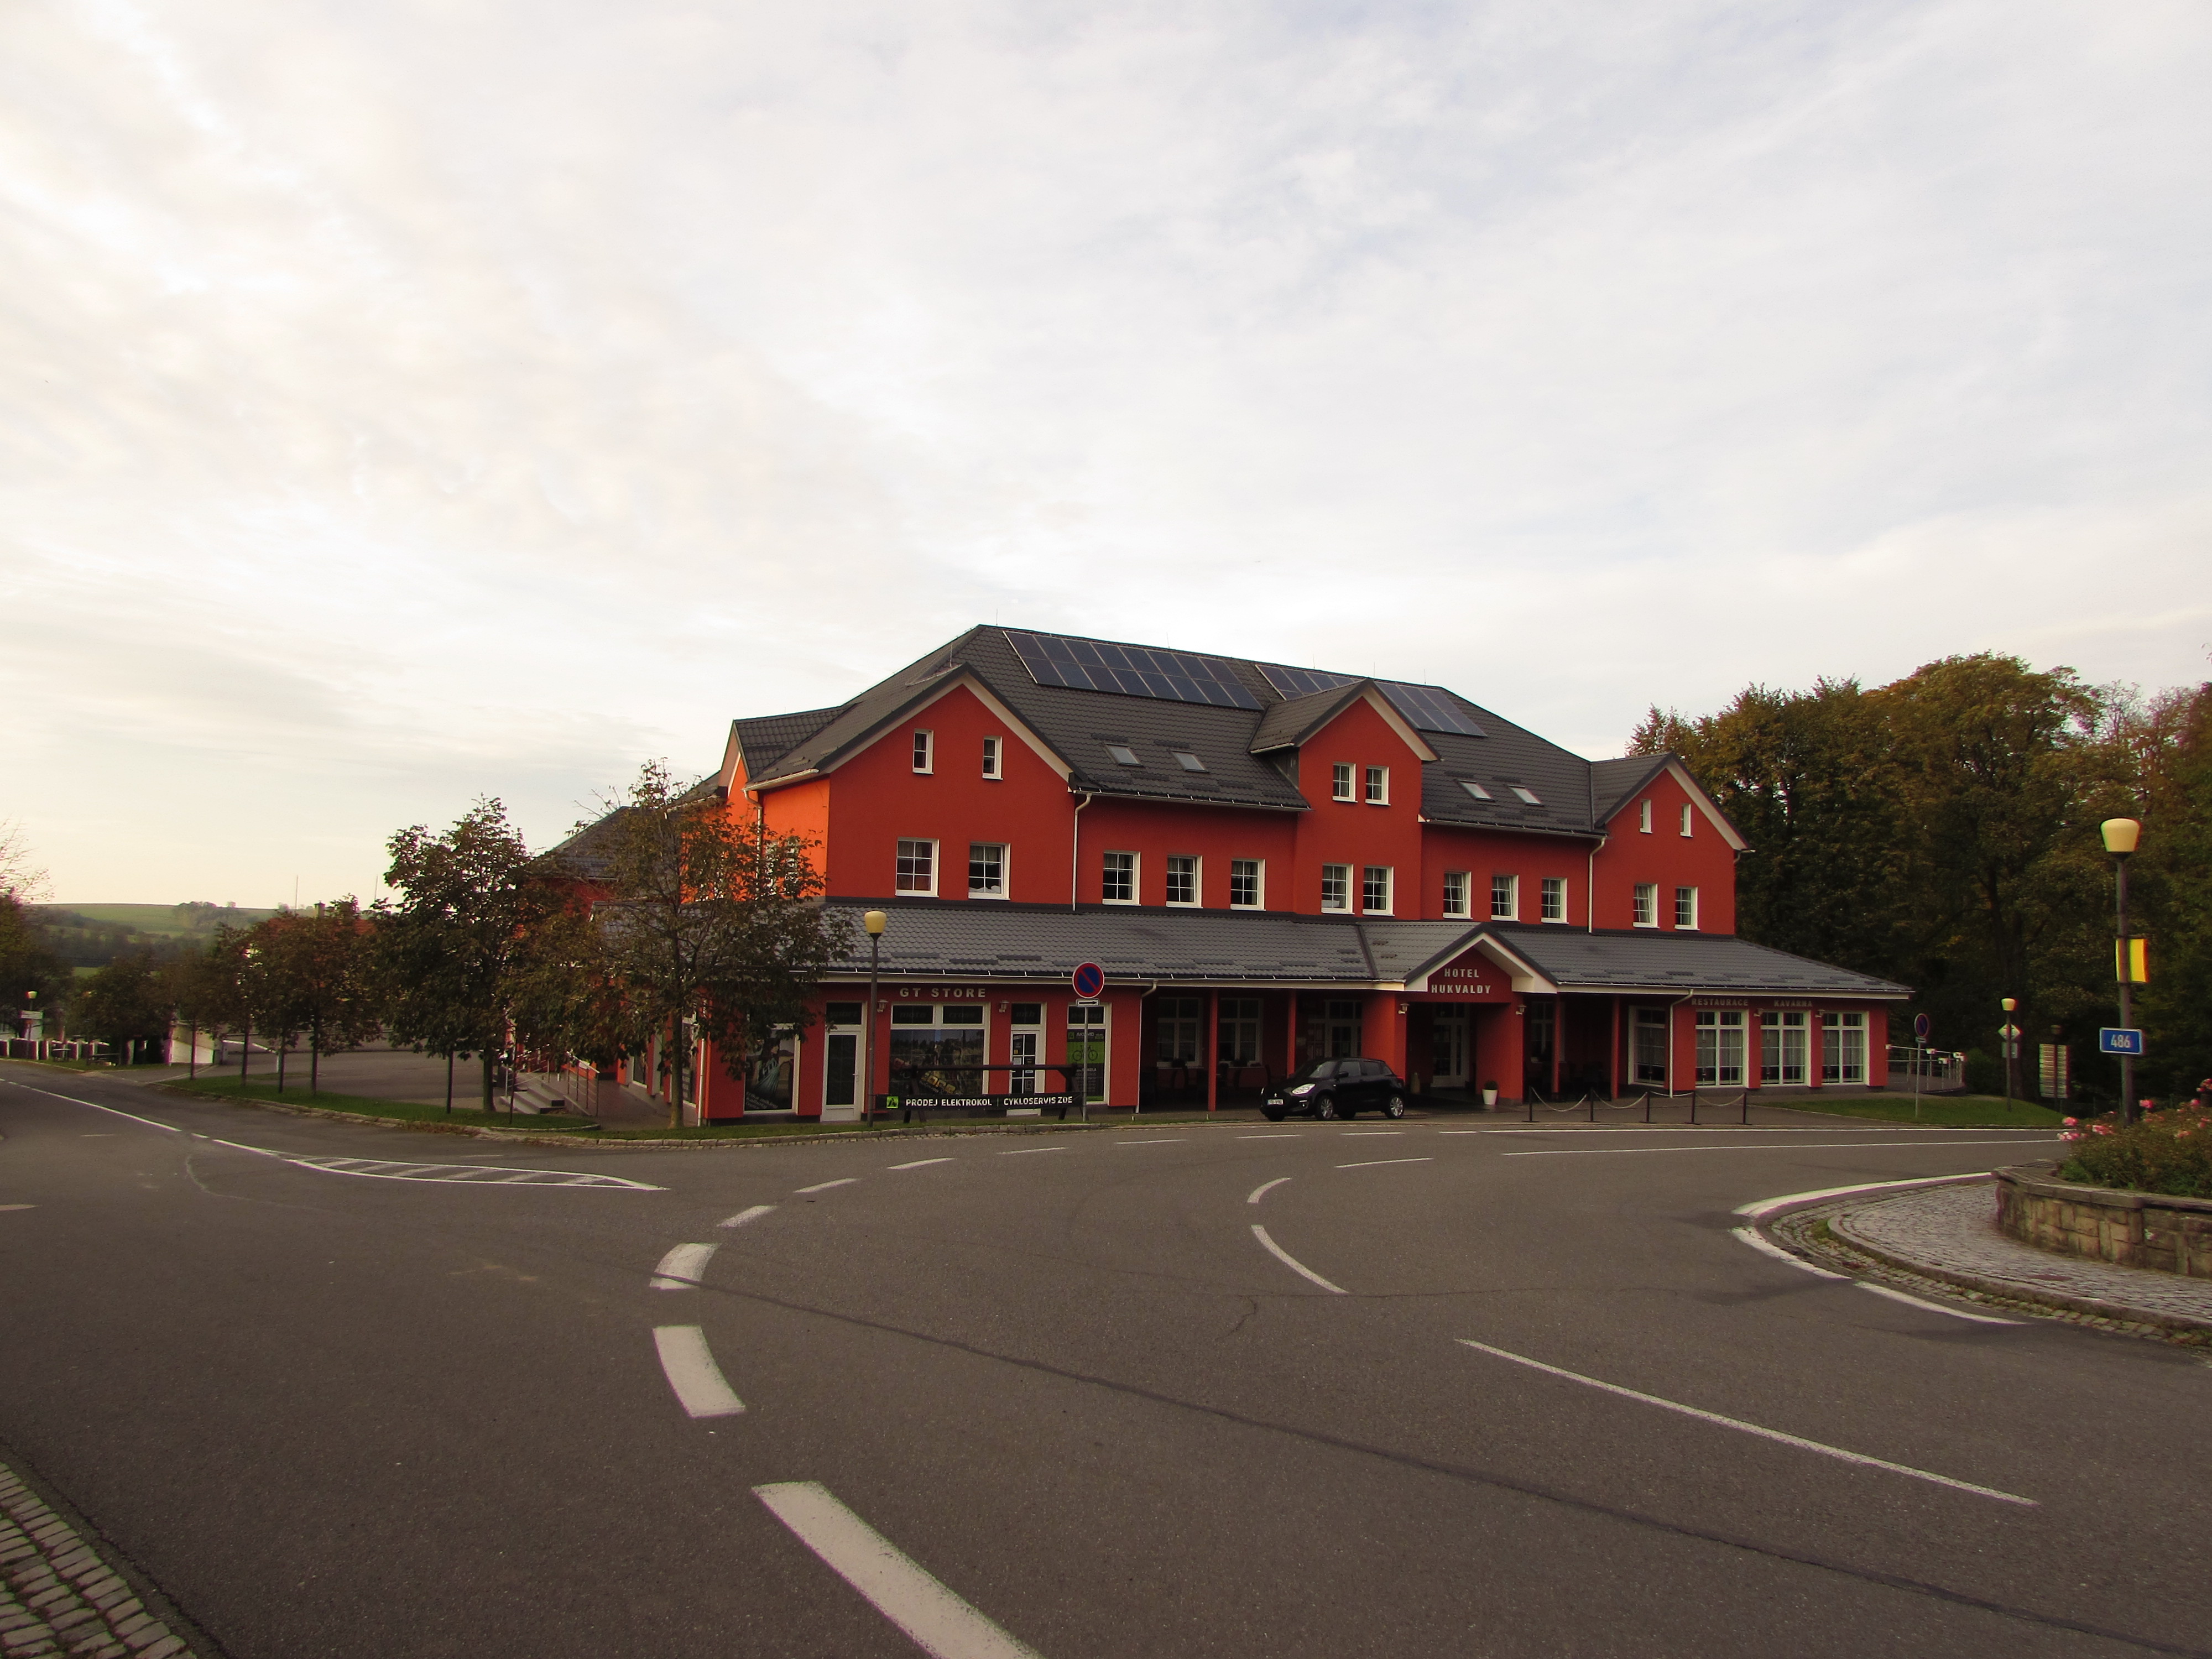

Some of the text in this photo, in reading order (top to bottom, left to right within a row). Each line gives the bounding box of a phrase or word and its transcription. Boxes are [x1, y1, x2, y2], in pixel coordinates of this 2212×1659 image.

[1444, 968, 1479, 978] HOTEL
[899, 988, 987, 998] GT STORE
[1431, 984, 1491, 994] HUKVALDY
[1691, 998, 1749, 1006] RESTAURACE
[2111, 1034, 2131, 1048] 486
[941, 1098, 992, 1107] ELEKTROKOL
[1004, 1097, 1056, 1105] CYKLOSERVIS
